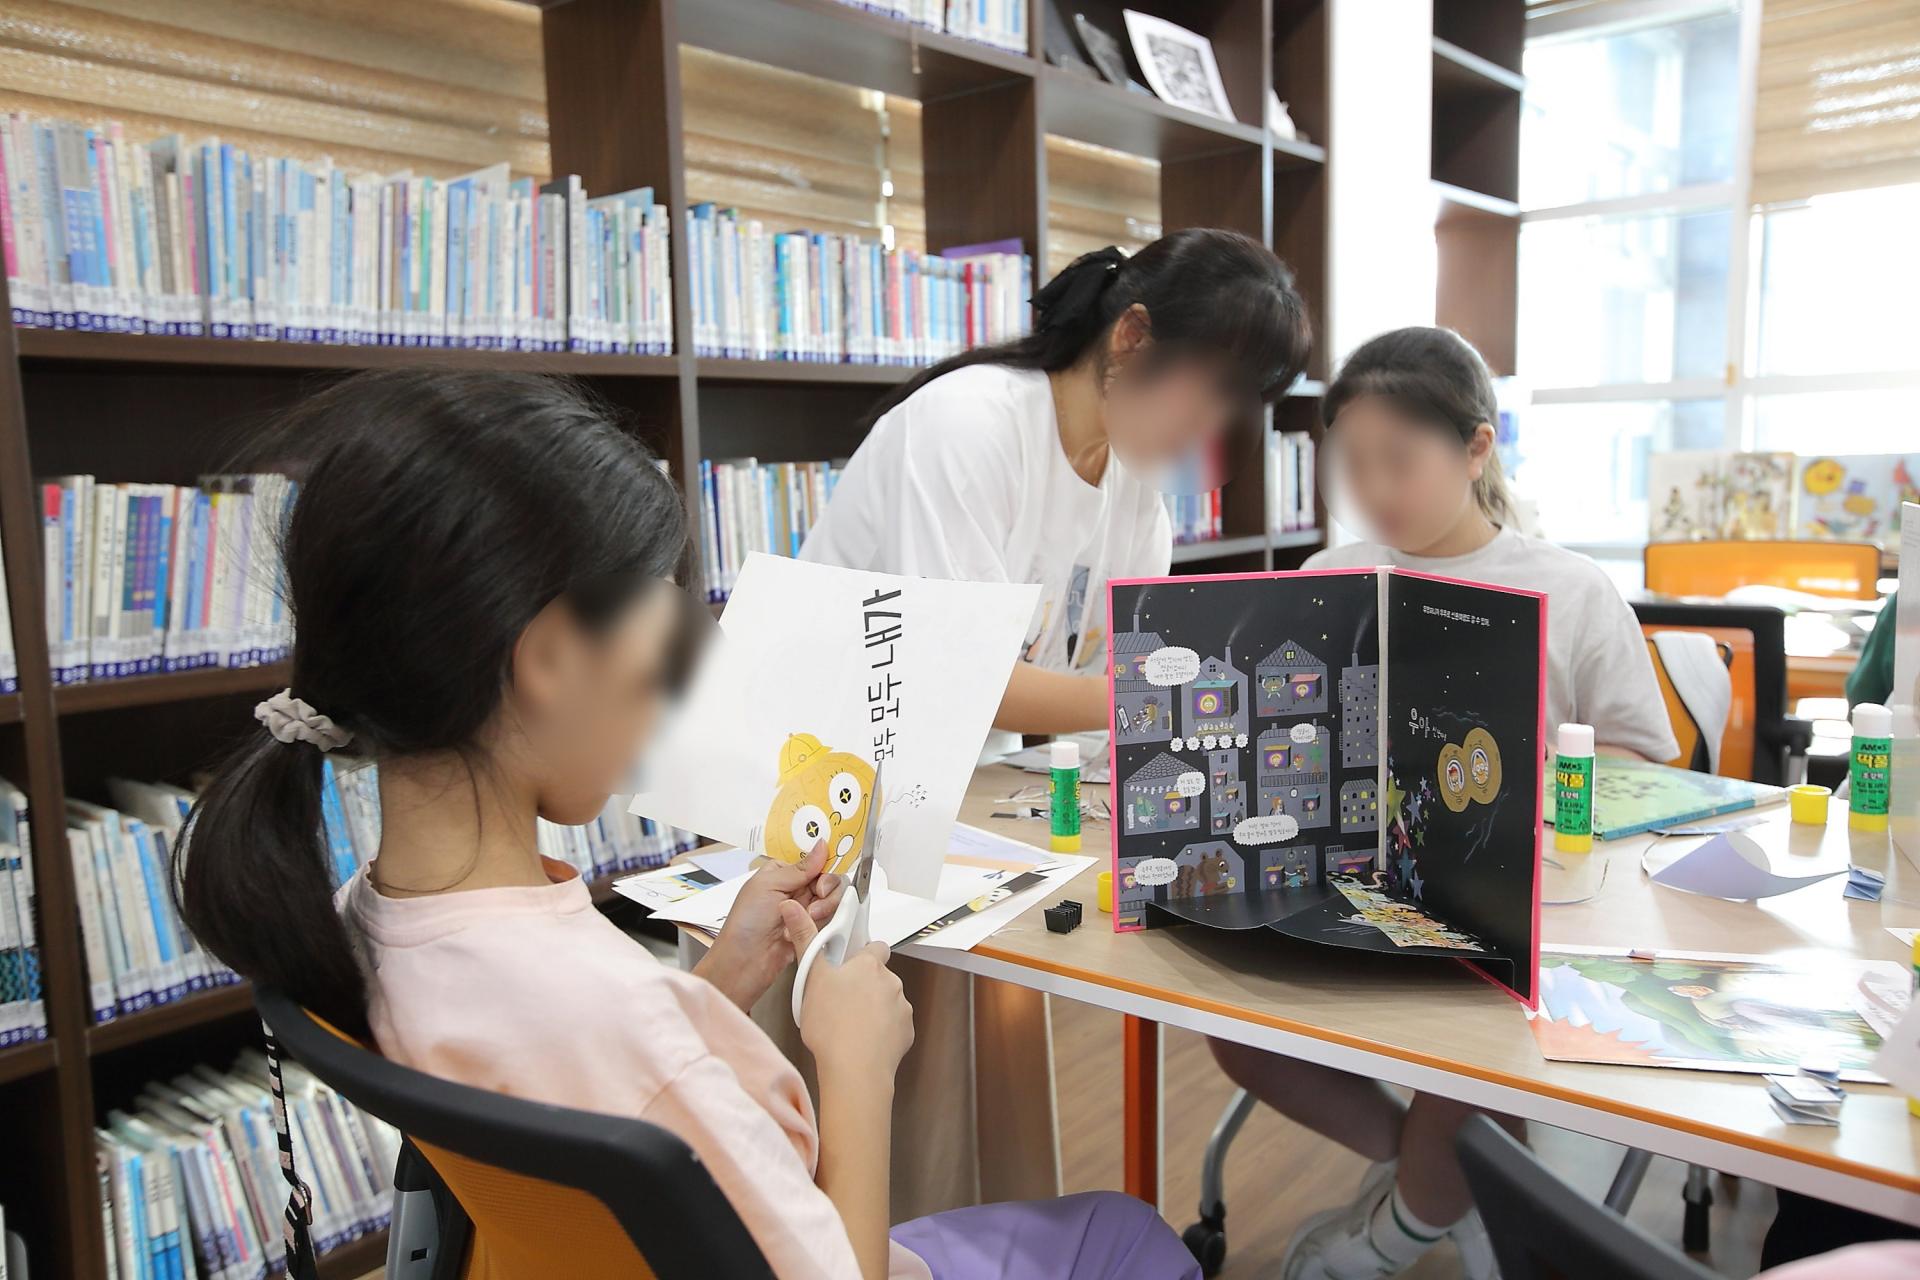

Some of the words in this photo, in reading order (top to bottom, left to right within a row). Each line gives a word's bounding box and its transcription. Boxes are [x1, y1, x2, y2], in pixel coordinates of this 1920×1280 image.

[863, 589, 902, 669] 내가
[868, 673, 902, 722] 모두
[874, 728, 896, 761] 모두
